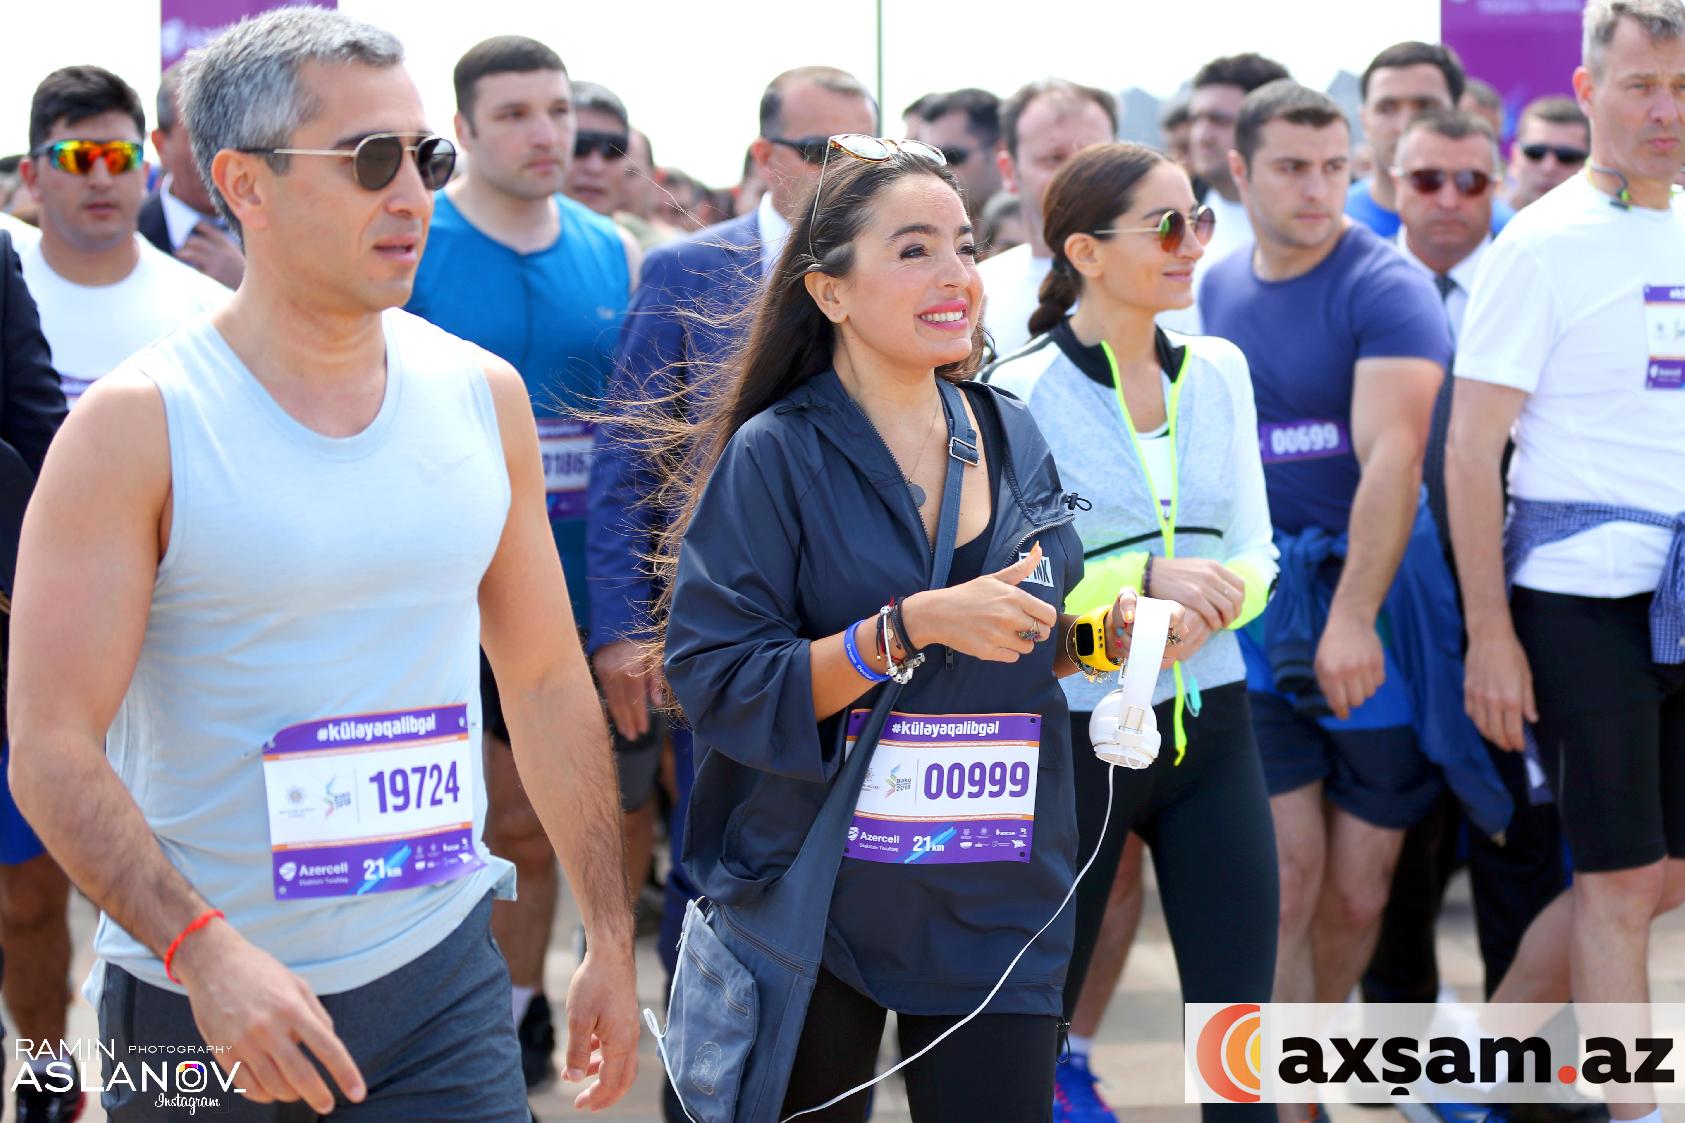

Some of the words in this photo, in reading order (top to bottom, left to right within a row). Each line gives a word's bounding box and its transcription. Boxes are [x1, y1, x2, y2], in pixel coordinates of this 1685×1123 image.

[1271, 422, 1340, 455] 00699
[316, 713, 436, 743] #küləyəqalibgəl
[891, 720, 1000, 738] #küləyəqalibgəl
[368, 760, 460, 814] 19724
[923, 761, 1030, 800] 00999
[860, 831, 900, 844] Azercell
[299, 862, 348, 877] Azercell
